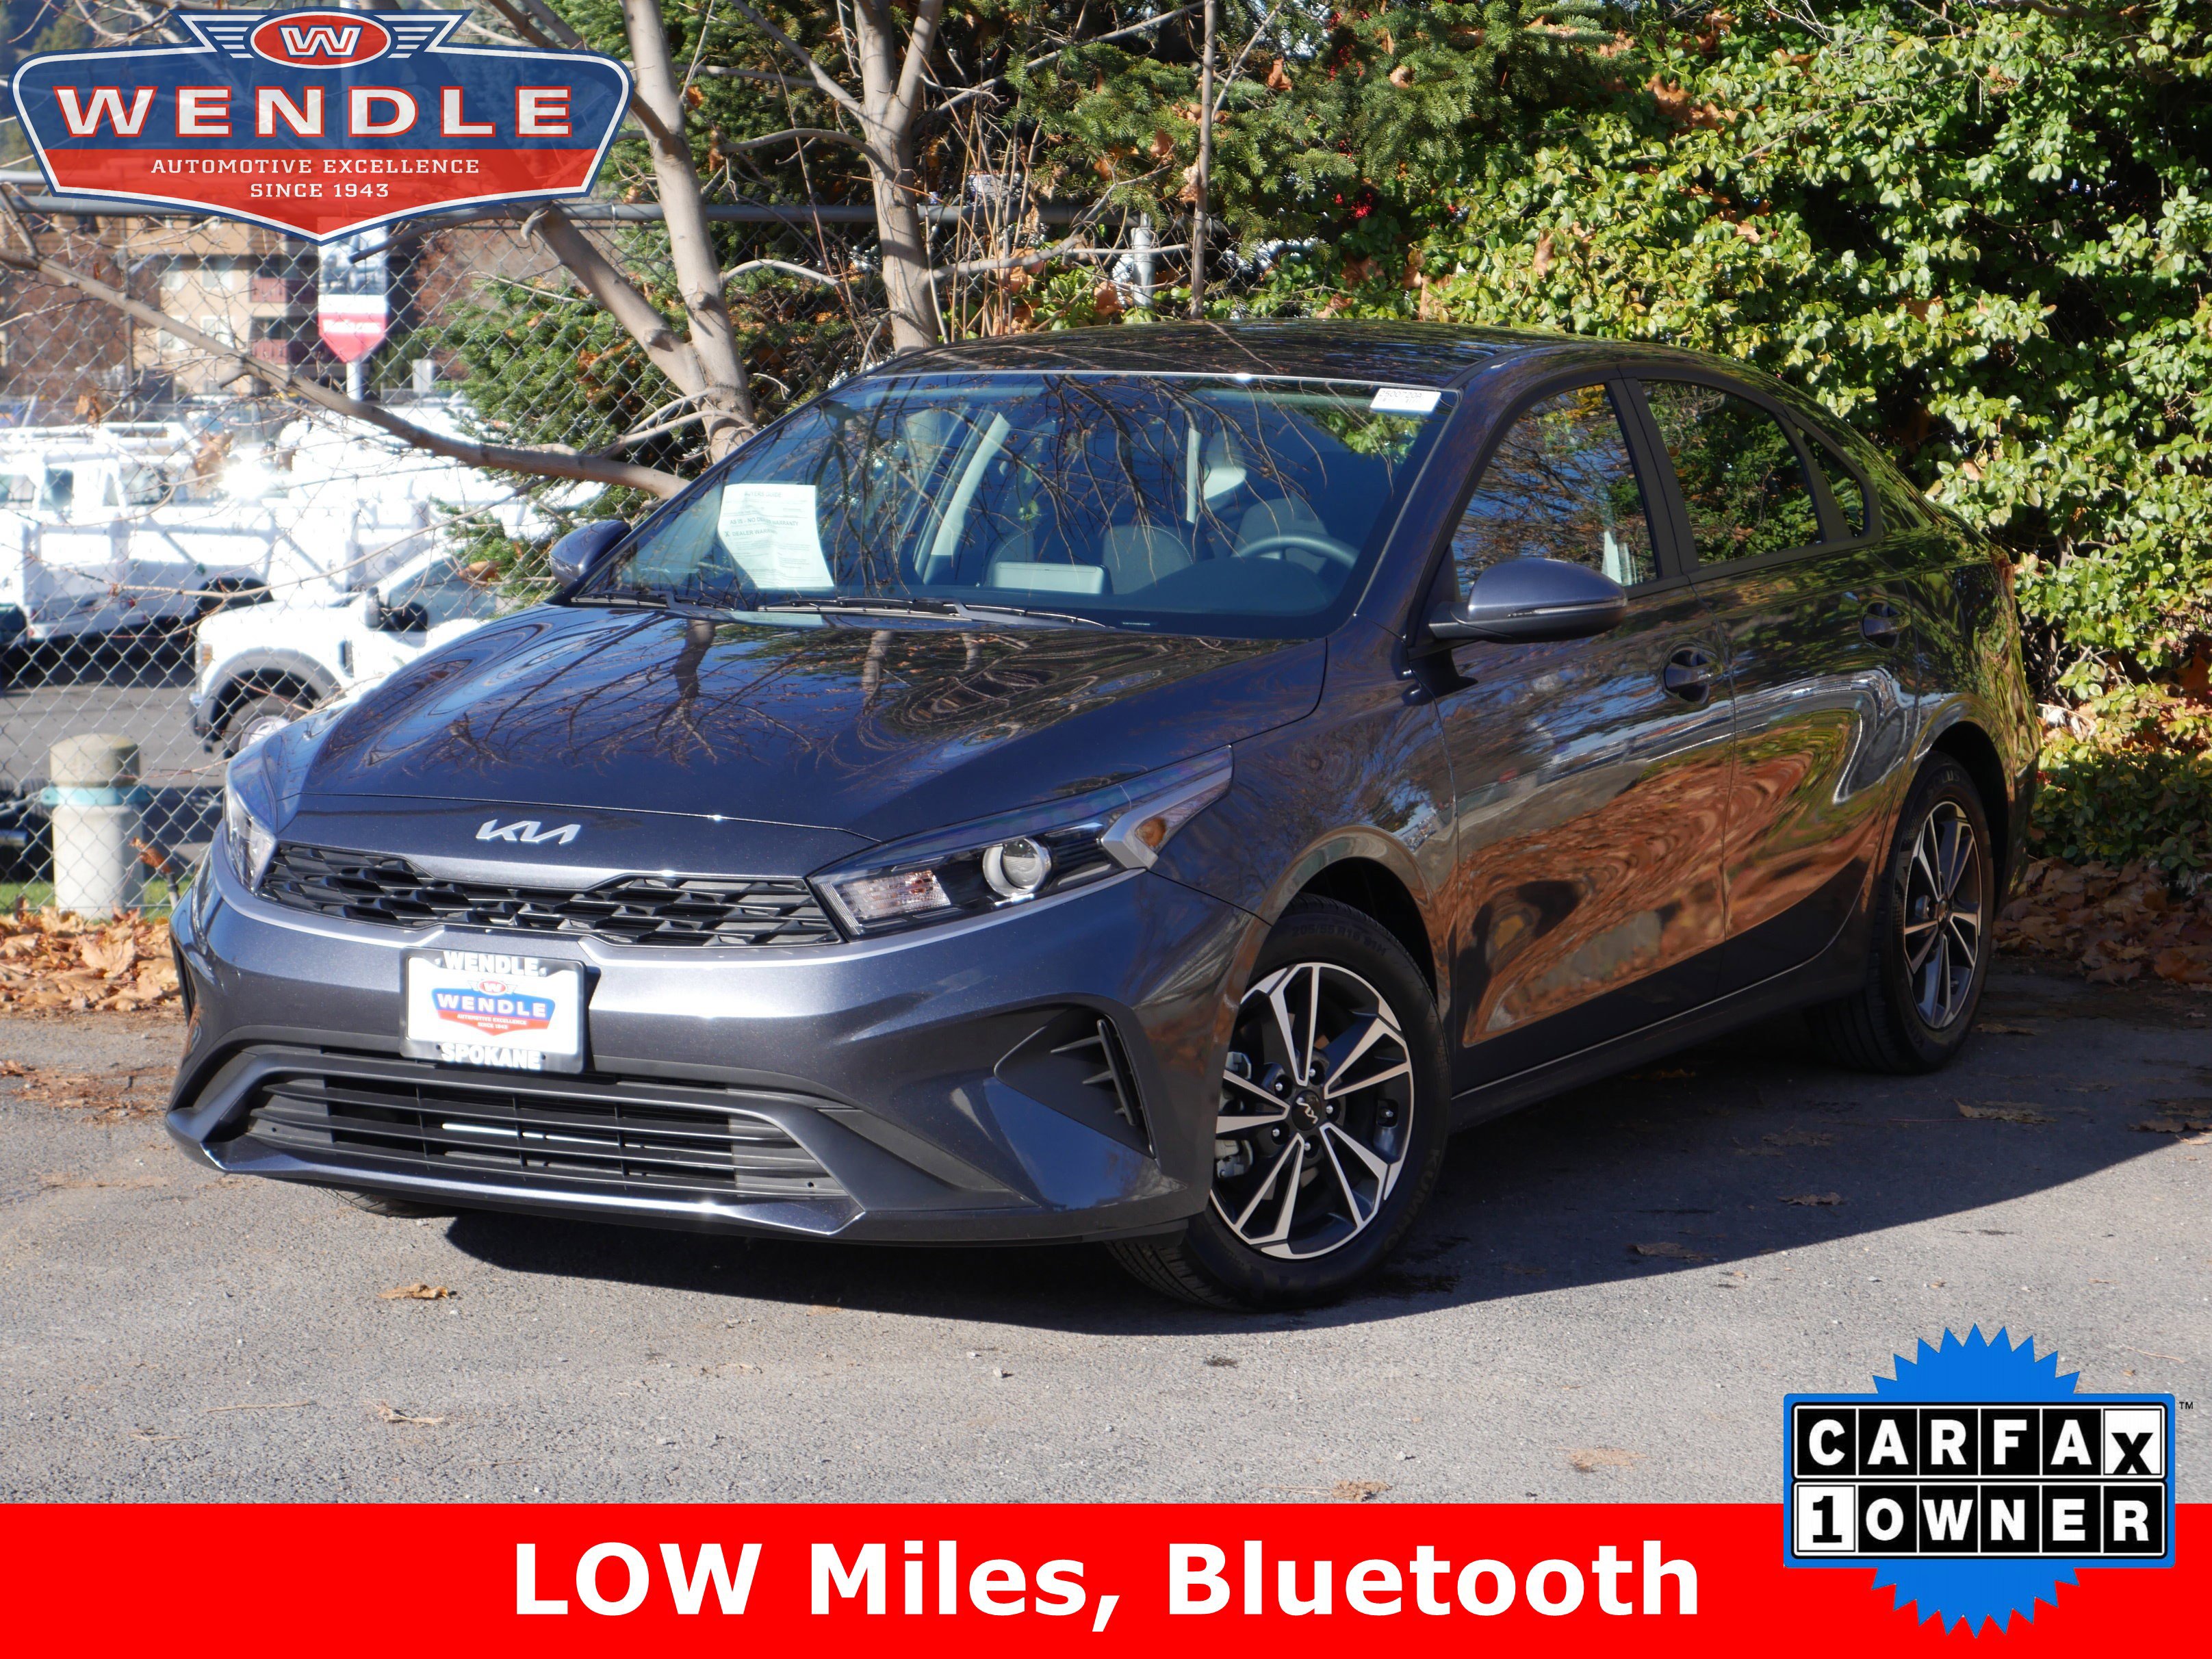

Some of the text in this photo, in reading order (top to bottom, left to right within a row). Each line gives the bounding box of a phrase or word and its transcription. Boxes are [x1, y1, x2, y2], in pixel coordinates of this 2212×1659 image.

[476, 819, 581, 845] KIA
[443, 951, 539, 976] WENDLE
[483, 981, 502, 992] W
[437, 993, 546, 1018] WENDLE
[441, 1042, 541, 1070] SPOKANE
